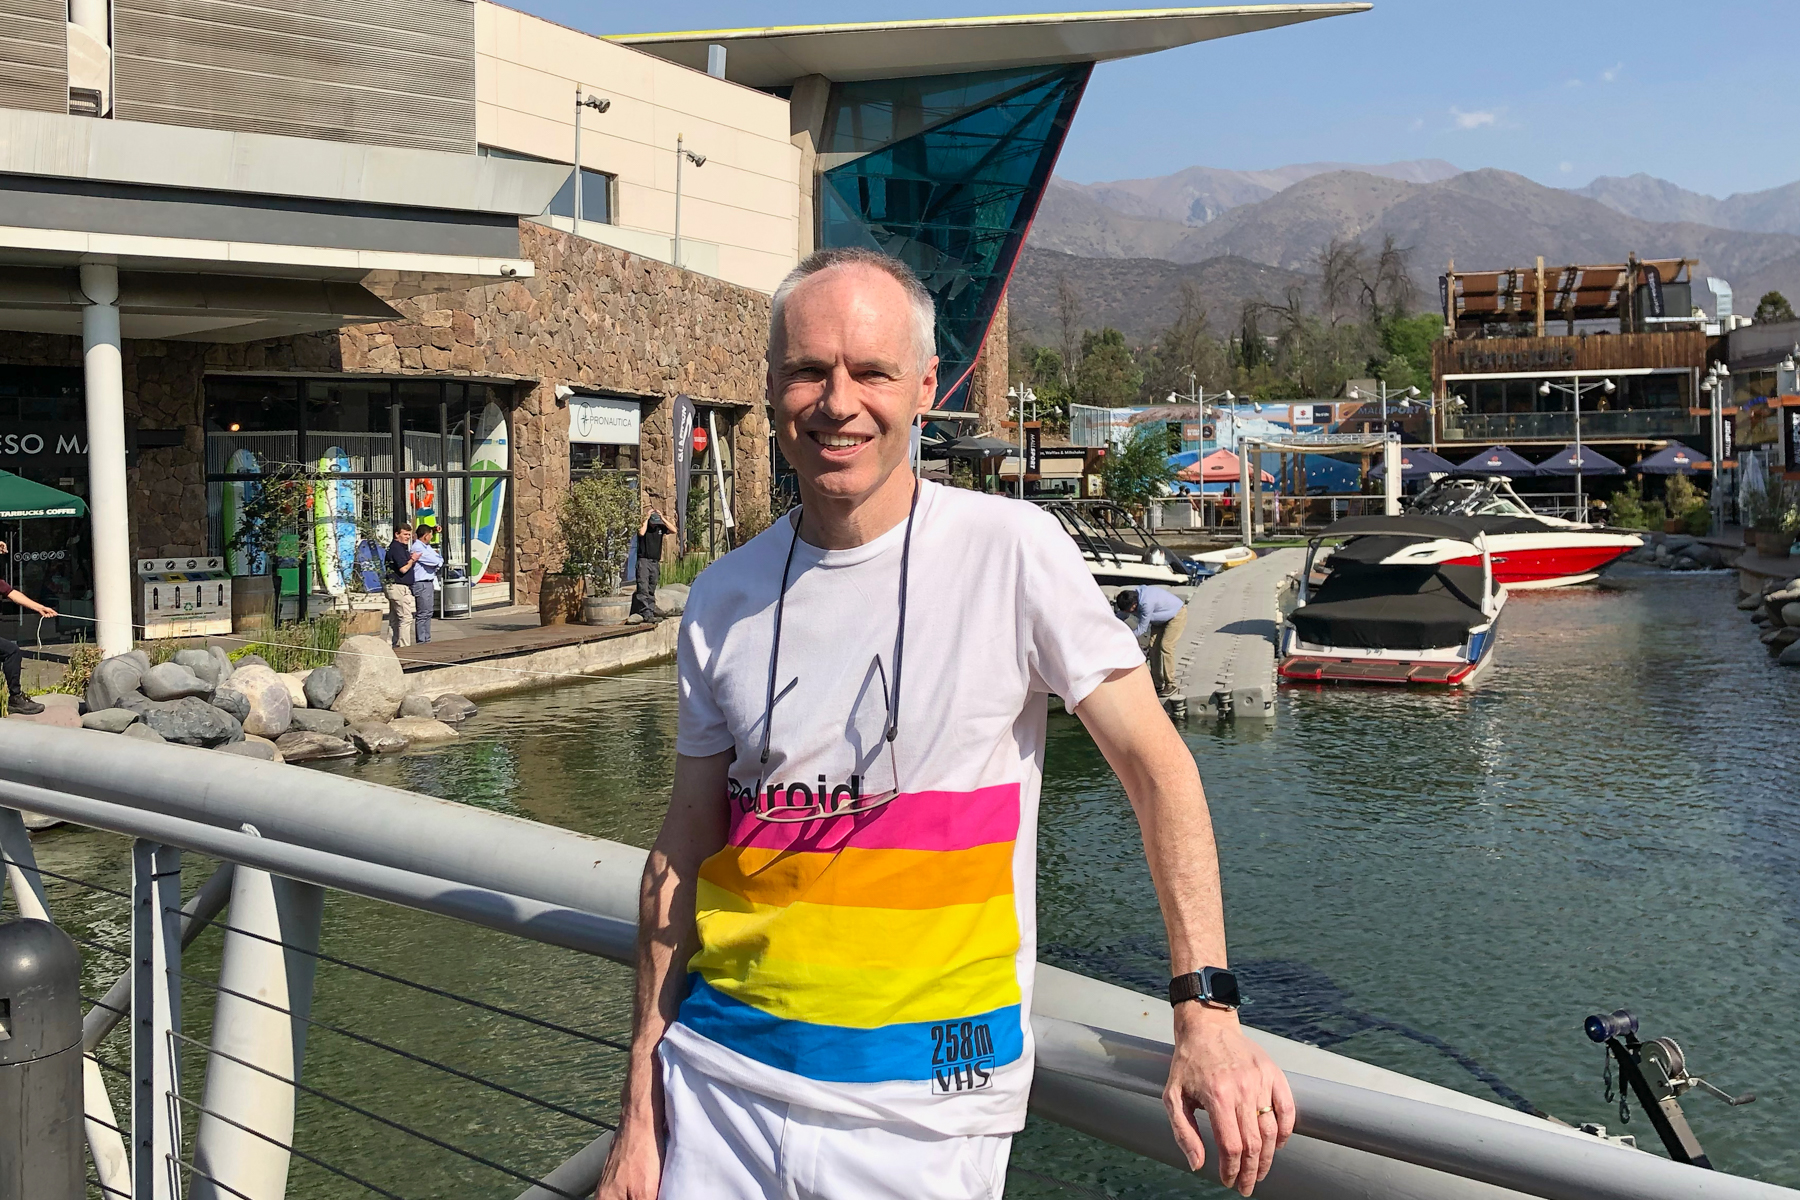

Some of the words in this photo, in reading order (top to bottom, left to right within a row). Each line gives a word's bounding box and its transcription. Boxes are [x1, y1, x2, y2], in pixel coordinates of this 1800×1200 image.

[589, 415, 632, 427] PRONAUTICA
[0, 433, 44, 455] SO
[0, 509, 44, 518] TARBUCKS
[931, 1021, 994, 1065] 258m
[935, 1059, 992, 1092] VHS
